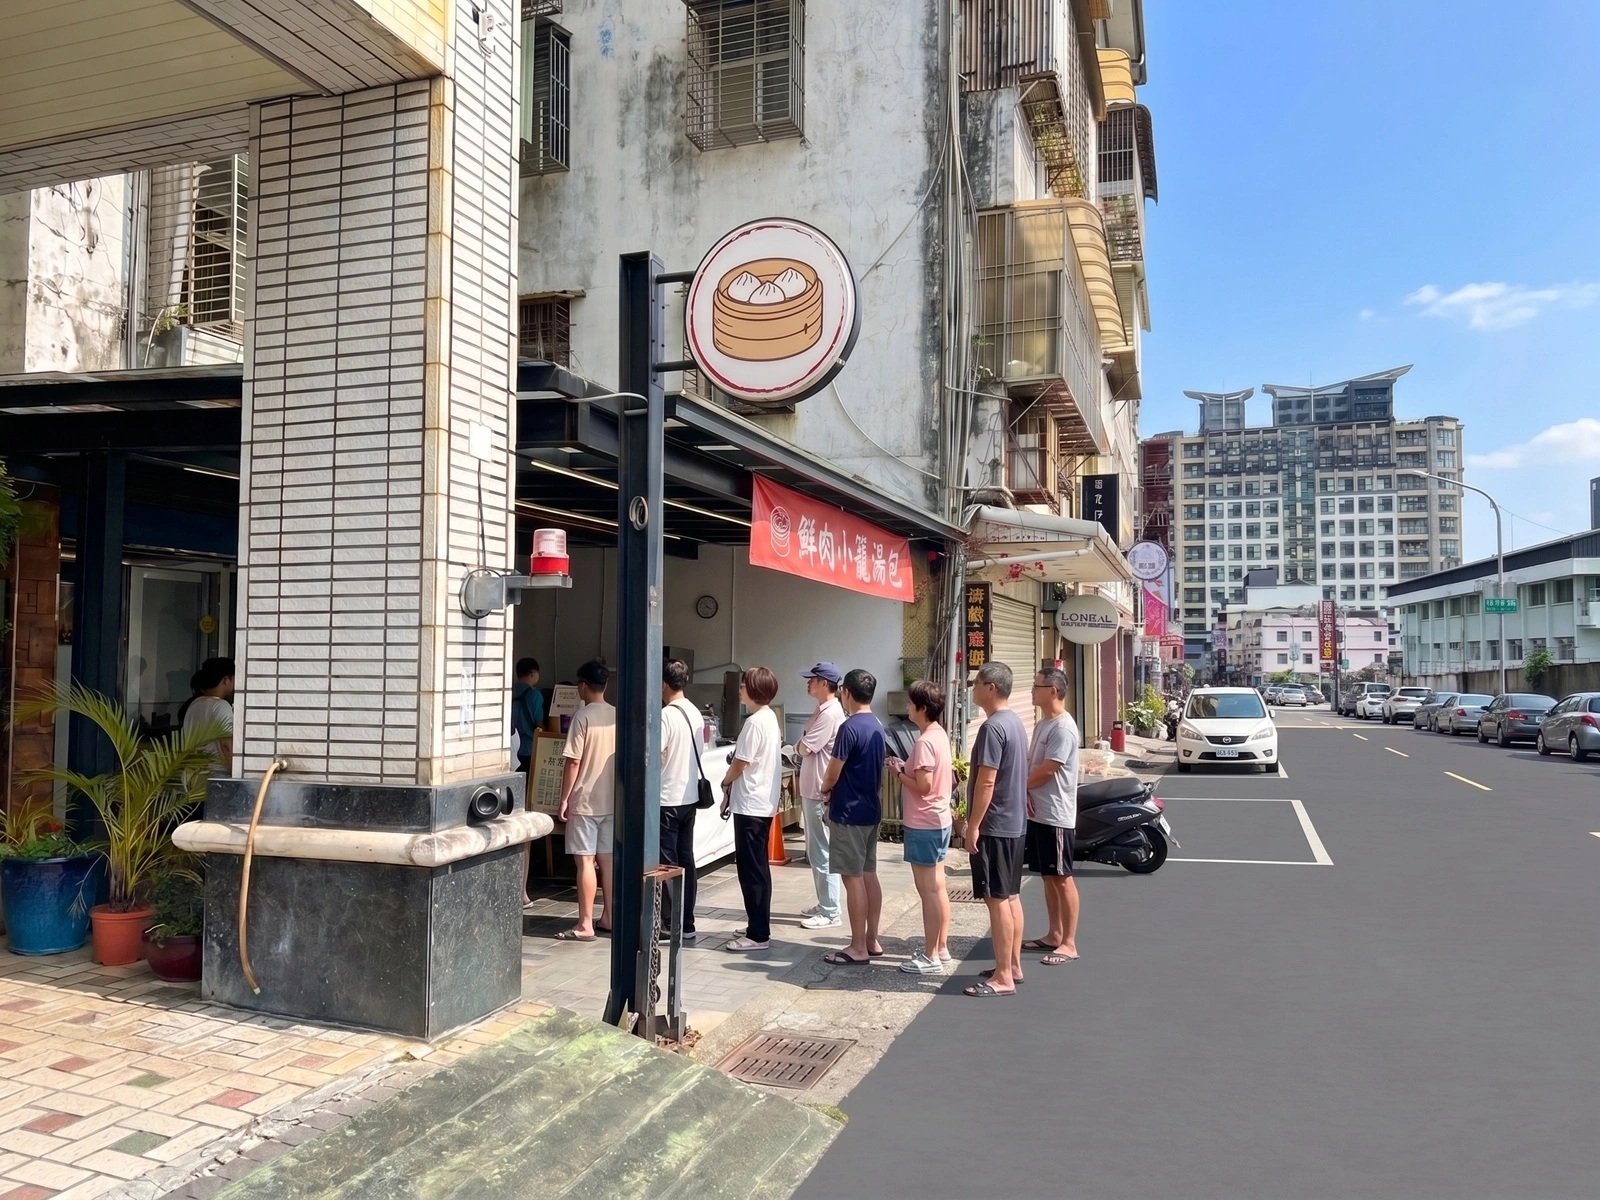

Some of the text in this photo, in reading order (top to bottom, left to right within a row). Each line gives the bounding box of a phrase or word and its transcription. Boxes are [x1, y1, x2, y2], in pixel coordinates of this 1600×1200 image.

[797, 515, 902, 588] 鮮肉小籠湯包
